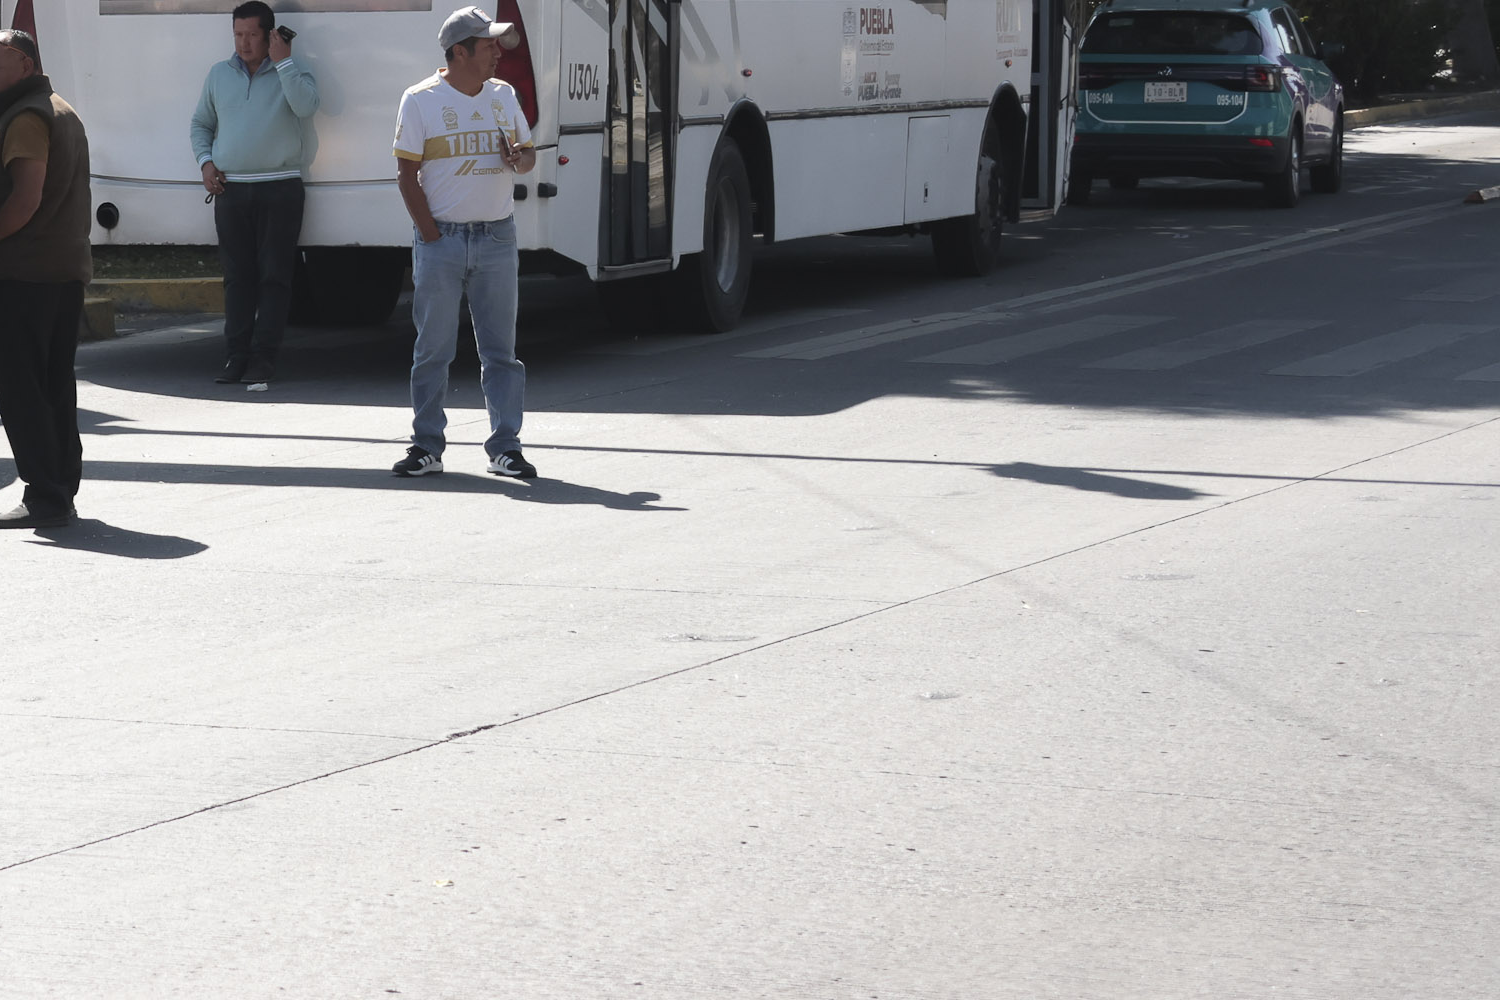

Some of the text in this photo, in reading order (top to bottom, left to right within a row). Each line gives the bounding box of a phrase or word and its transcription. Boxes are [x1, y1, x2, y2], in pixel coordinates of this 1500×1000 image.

[860, 8, 894, 34] PUEBLA
[568, 63, 599, 100] U304
[1217, 95, 1243, 106] 095-104
